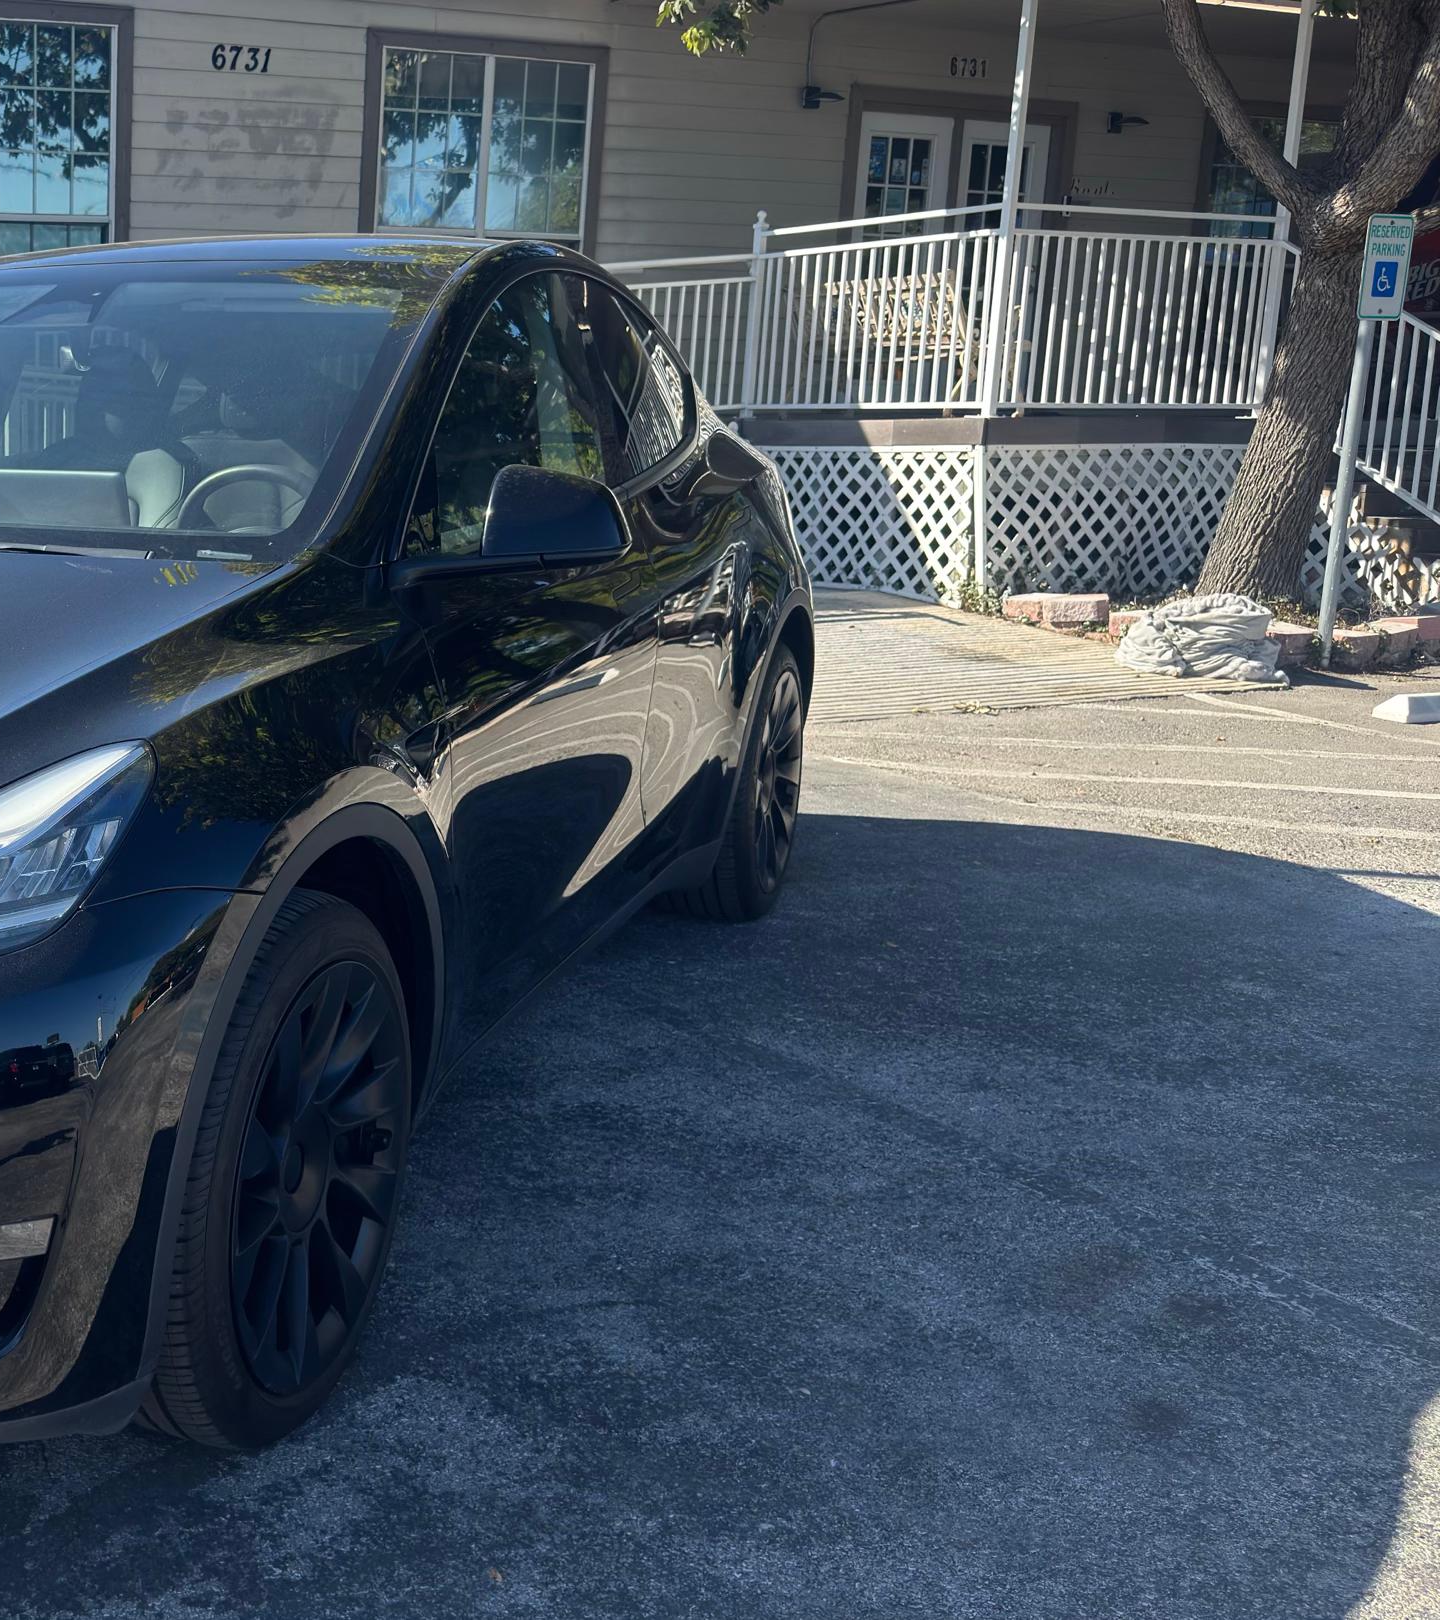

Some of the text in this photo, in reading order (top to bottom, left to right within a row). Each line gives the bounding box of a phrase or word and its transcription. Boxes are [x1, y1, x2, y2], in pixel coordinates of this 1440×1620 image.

[211, 44, 272, 73] 6731
[950, 57, 987, 78] 6731
[1370, 225, 1410, 239] RESERVED
[1371, 242, 1406, 256] PARKING
